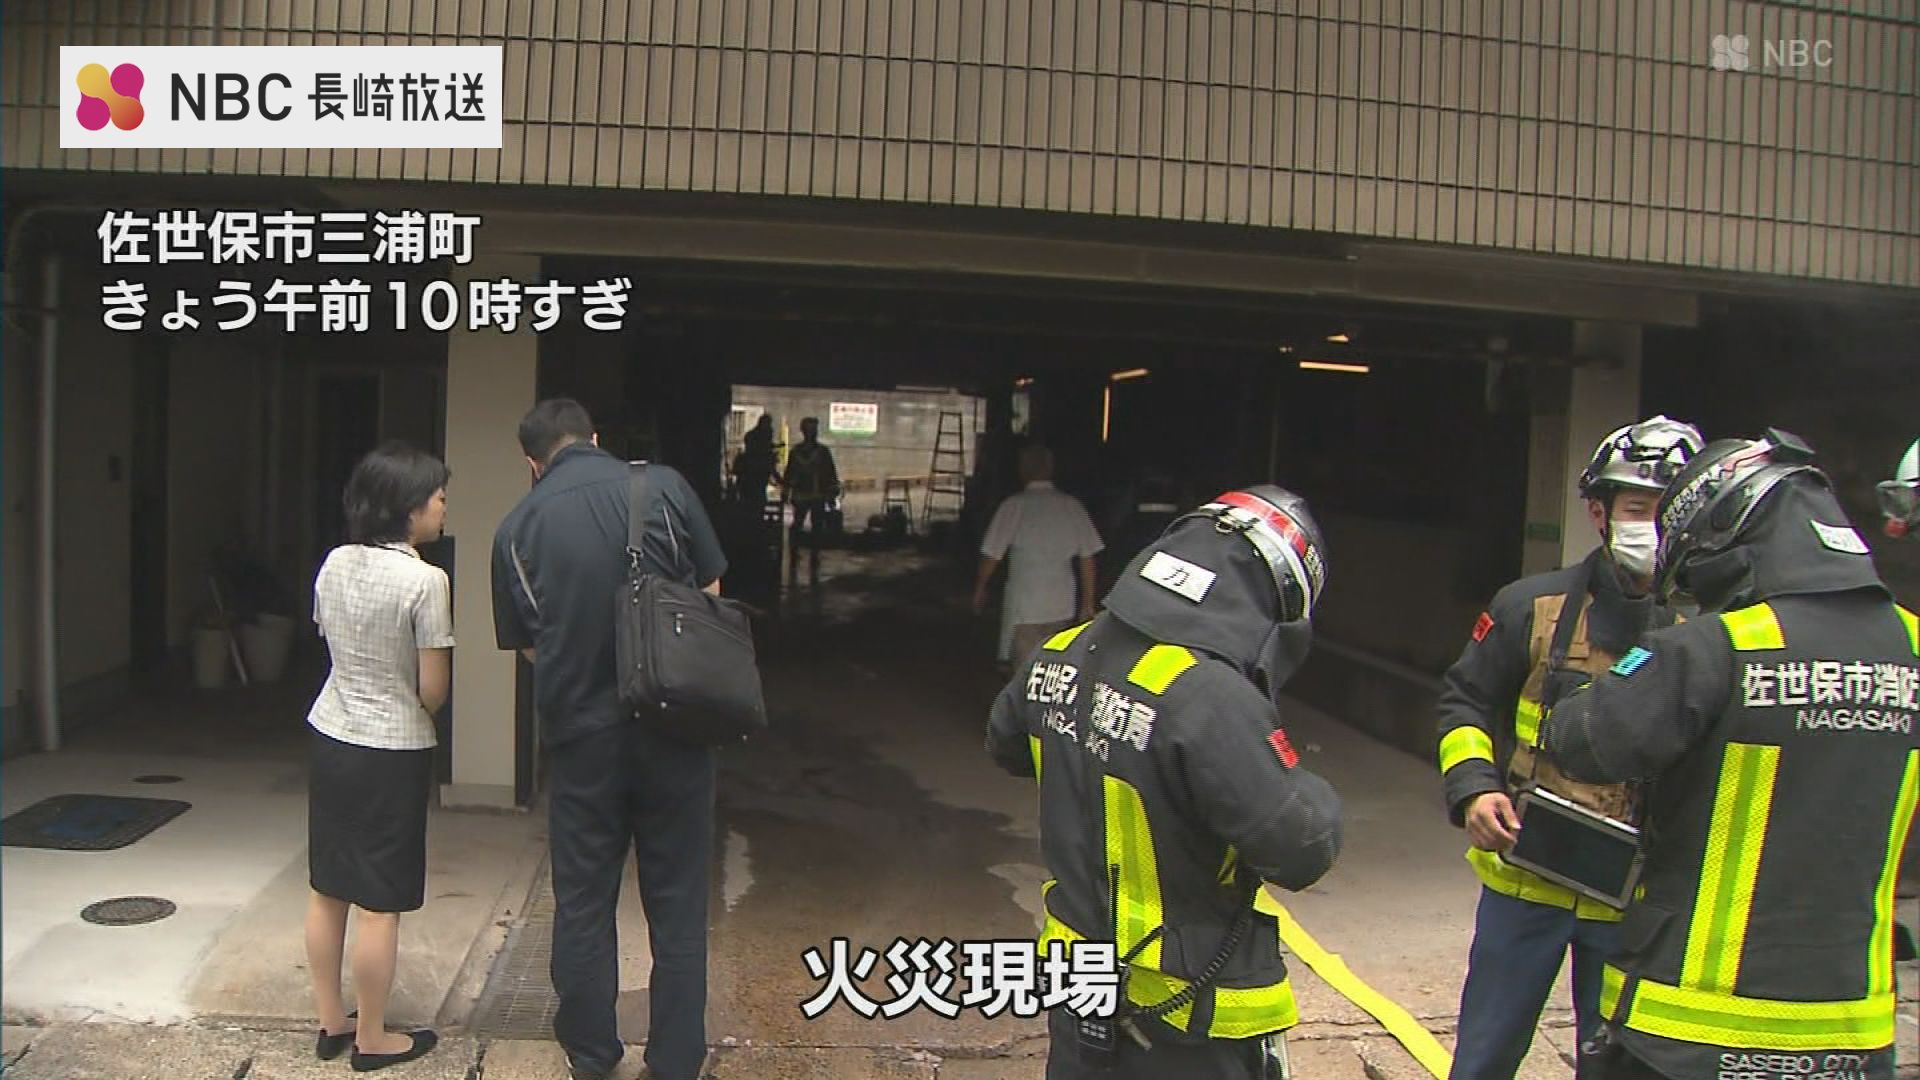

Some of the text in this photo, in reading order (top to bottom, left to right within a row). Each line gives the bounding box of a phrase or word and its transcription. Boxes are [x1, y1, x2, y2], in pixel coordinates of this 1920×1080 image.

[1027, 660, 1157, 752] 佐世保消防局
[1719, 1053, 1815, 1073] SASEBO
